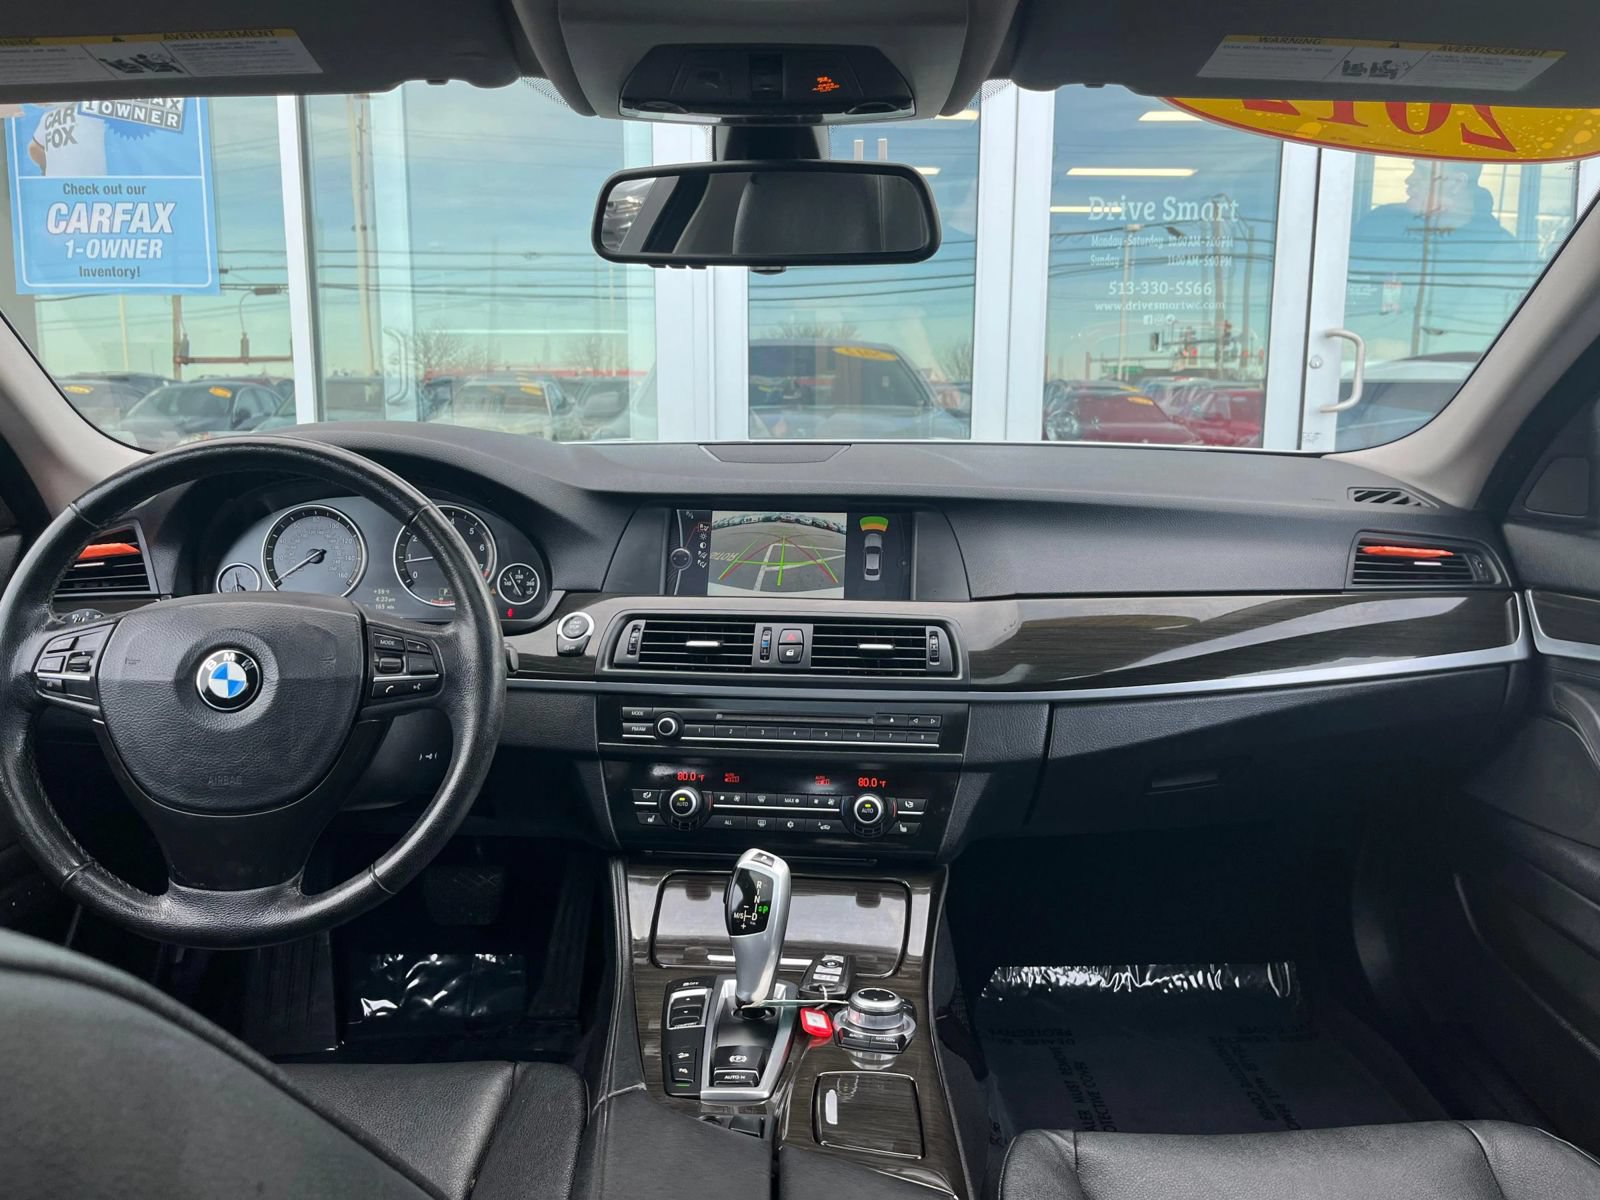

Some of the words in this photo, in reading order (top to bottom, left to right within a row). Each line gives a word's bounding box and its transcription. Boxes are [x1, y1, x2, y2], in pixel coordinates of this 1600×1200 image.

[163, 29, 275, 40] AVERTISSEMENT
[1257, 36, 1322, 45] WARNING
[1438, 45, 1547, 57] AVERTISSEMENT
[44, 104, 76, 131] CAR
[101, 101, 178, 127] OWNER
[44, 125, 78, 152] FOX
[63, 183, 99, 195] Check
[103, 184, 122, 195] out
[125, 186, 146, 195] our
[1088, 195, 1156, 221] Drive
[1162, 196, 1239, 222] Smart
[47, 202, 176, 235] CARFAX
[65, 238, 163, 260] 1-OWNER
[1090, 253, 1120, 269] Sunday
[79, 265, 140, 279] Inventory!
[1108, 281, 1213, 296] 513-330-5566
[205, 652, 255, 671] BMW
[677, 772, 696, 781] 80.0
[858, 778, 878, 788] 80.0
[756, 880, 762, 888] R
[754, 895, 760, 904] N
